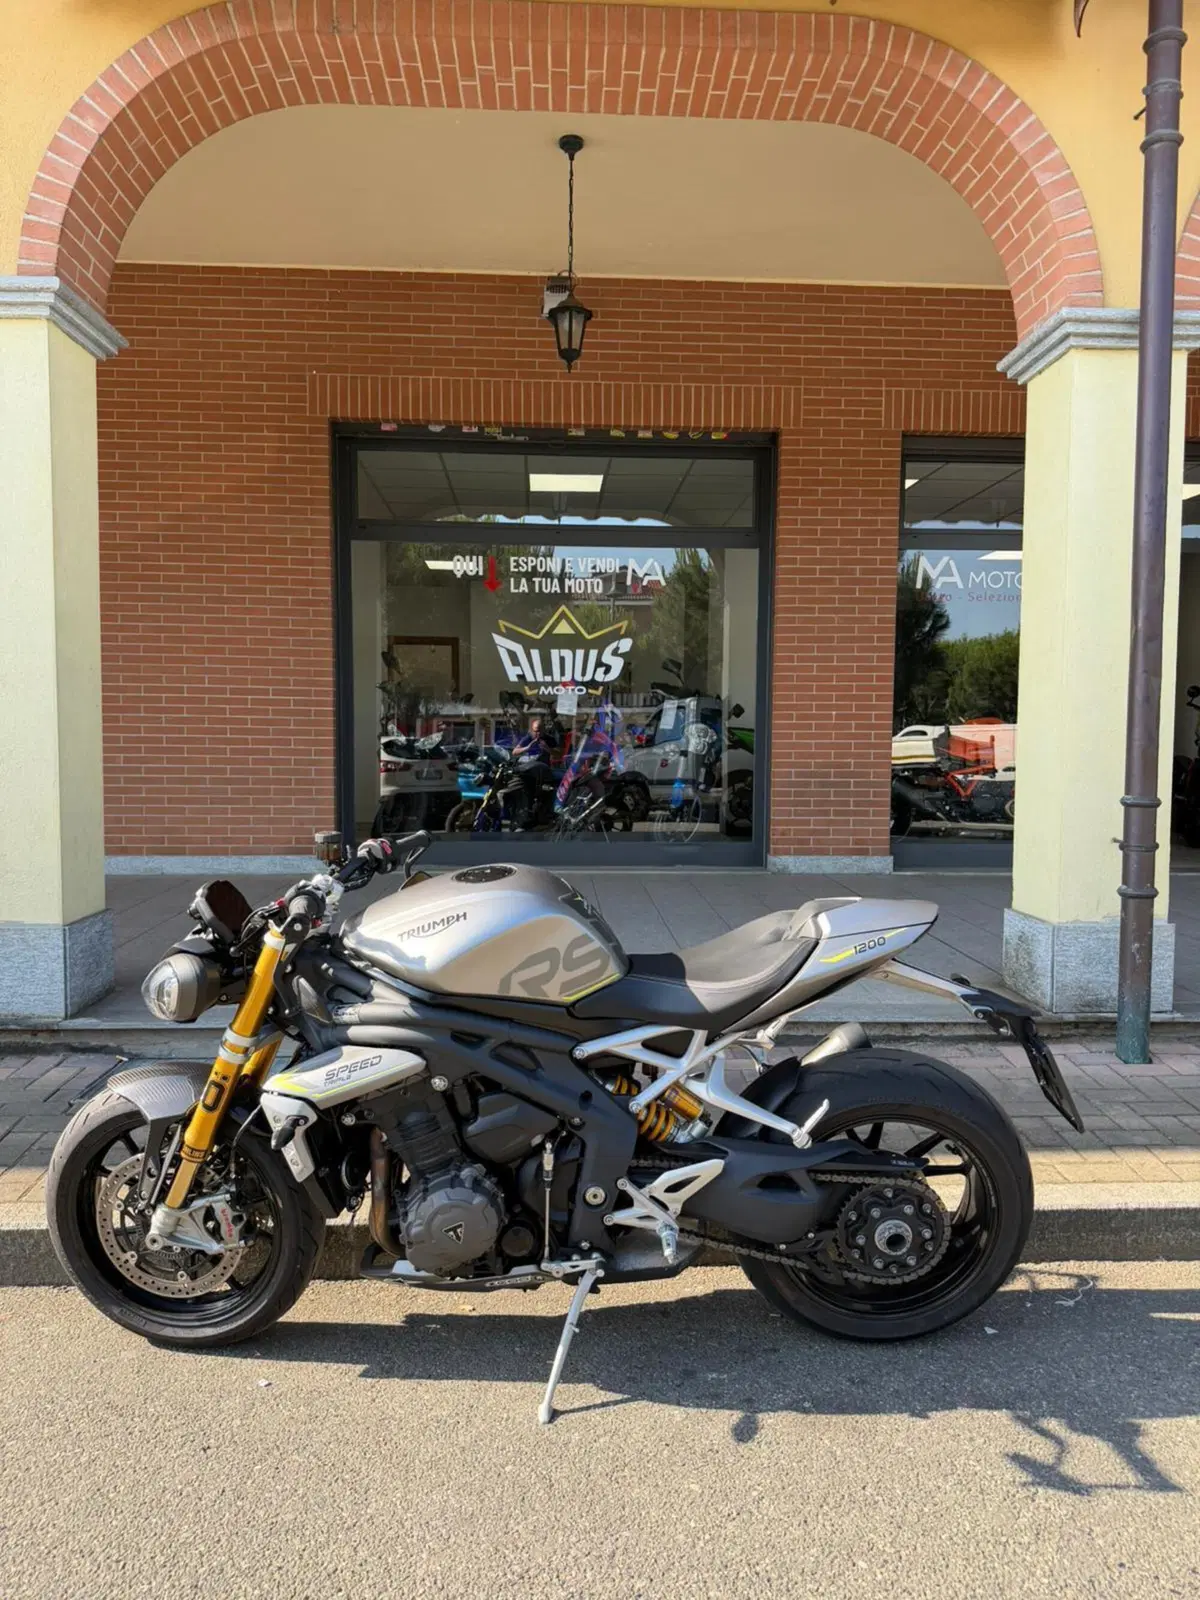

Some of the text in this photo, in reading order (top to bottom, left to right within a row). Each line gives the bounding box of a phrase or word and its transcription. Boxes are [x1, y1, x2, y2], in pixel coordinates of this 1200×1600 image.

[452, 555, 484, 578] QUI
[510, 557, 620, 573] ESPONI E VENDI
[510, 577, 603, 593] LA TUA MOTO
[491, 632, 633, 683] ALDUS
[538, 686, 587, 696] MOTO
[397, 911, 468, 942] TRIUMPH
[853, 936, 886, 955] 1200
[498, 933, 610, 998] RS
[325, 1054, 383, 1081] SPEED
